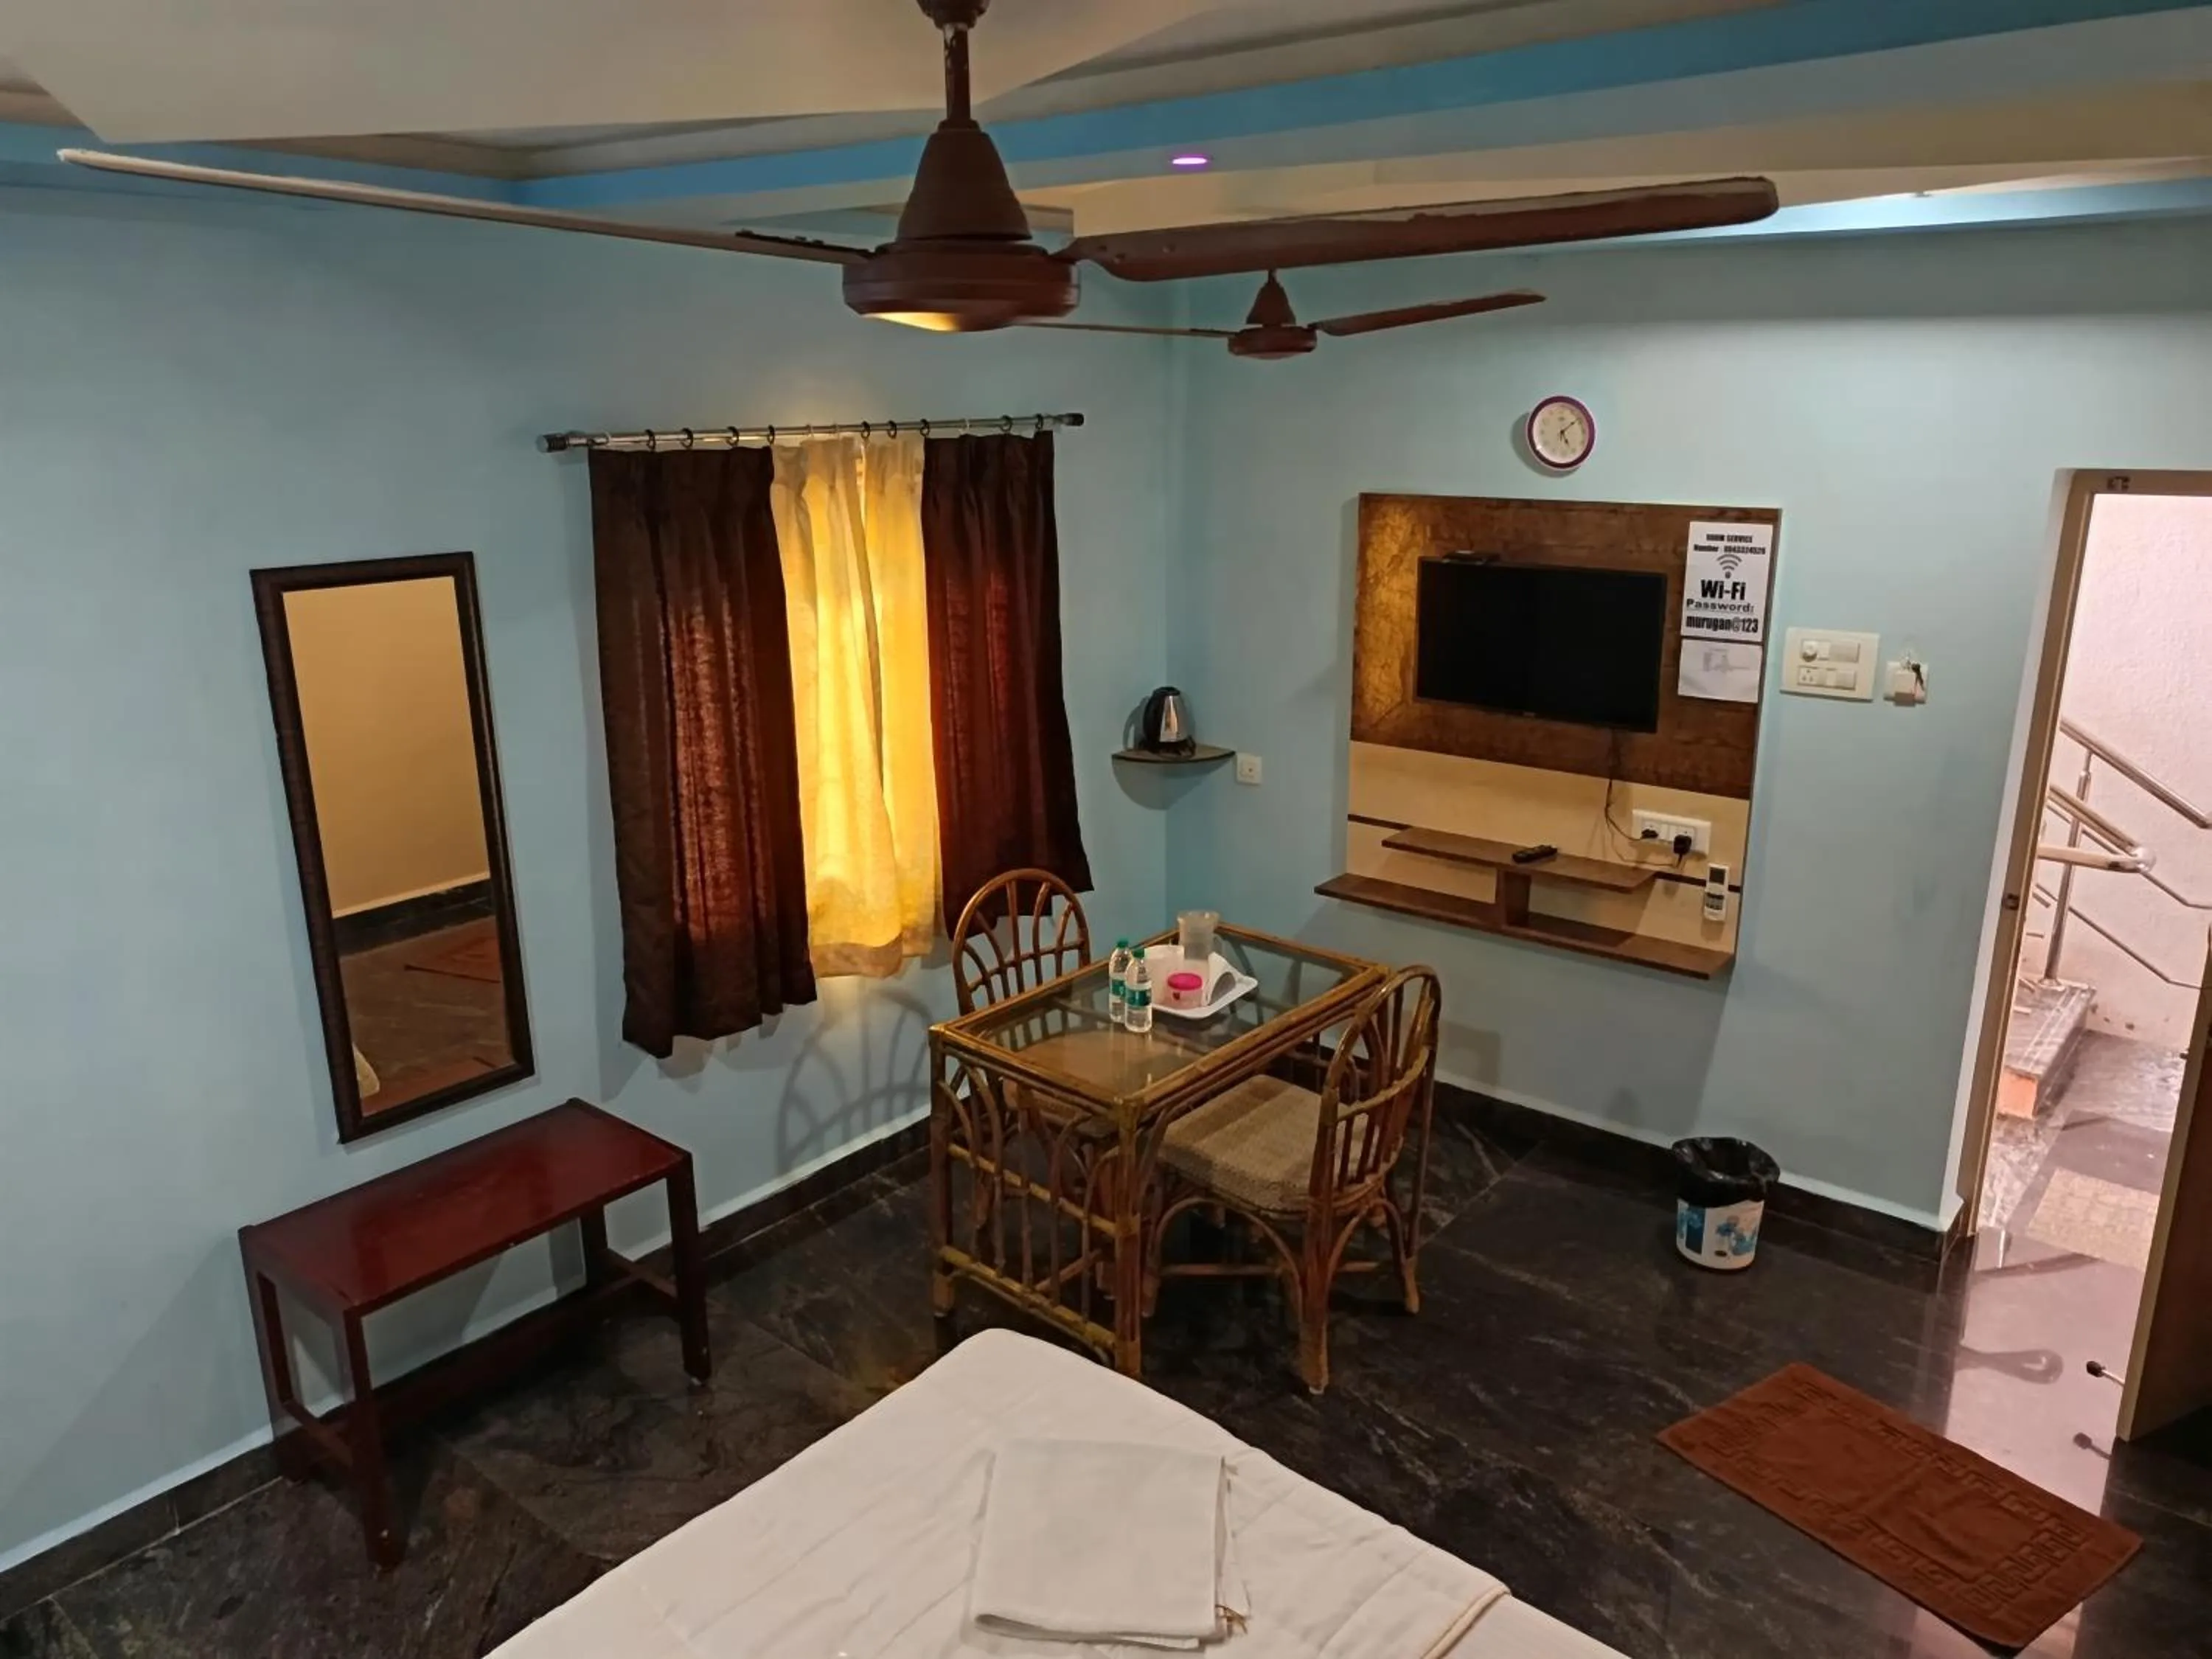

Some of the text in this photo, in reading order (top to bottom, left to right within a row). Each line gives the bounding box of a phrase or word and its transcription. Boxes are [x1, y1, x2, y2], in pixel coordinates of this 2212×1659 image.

[1727, 535, 1753, 543] SERVICE
[1701, 579, 1746, 600] Wi-Fi
[1686, 598, 1754, 613] Password:
[1686, 616, 1759, 633] murugan@123
